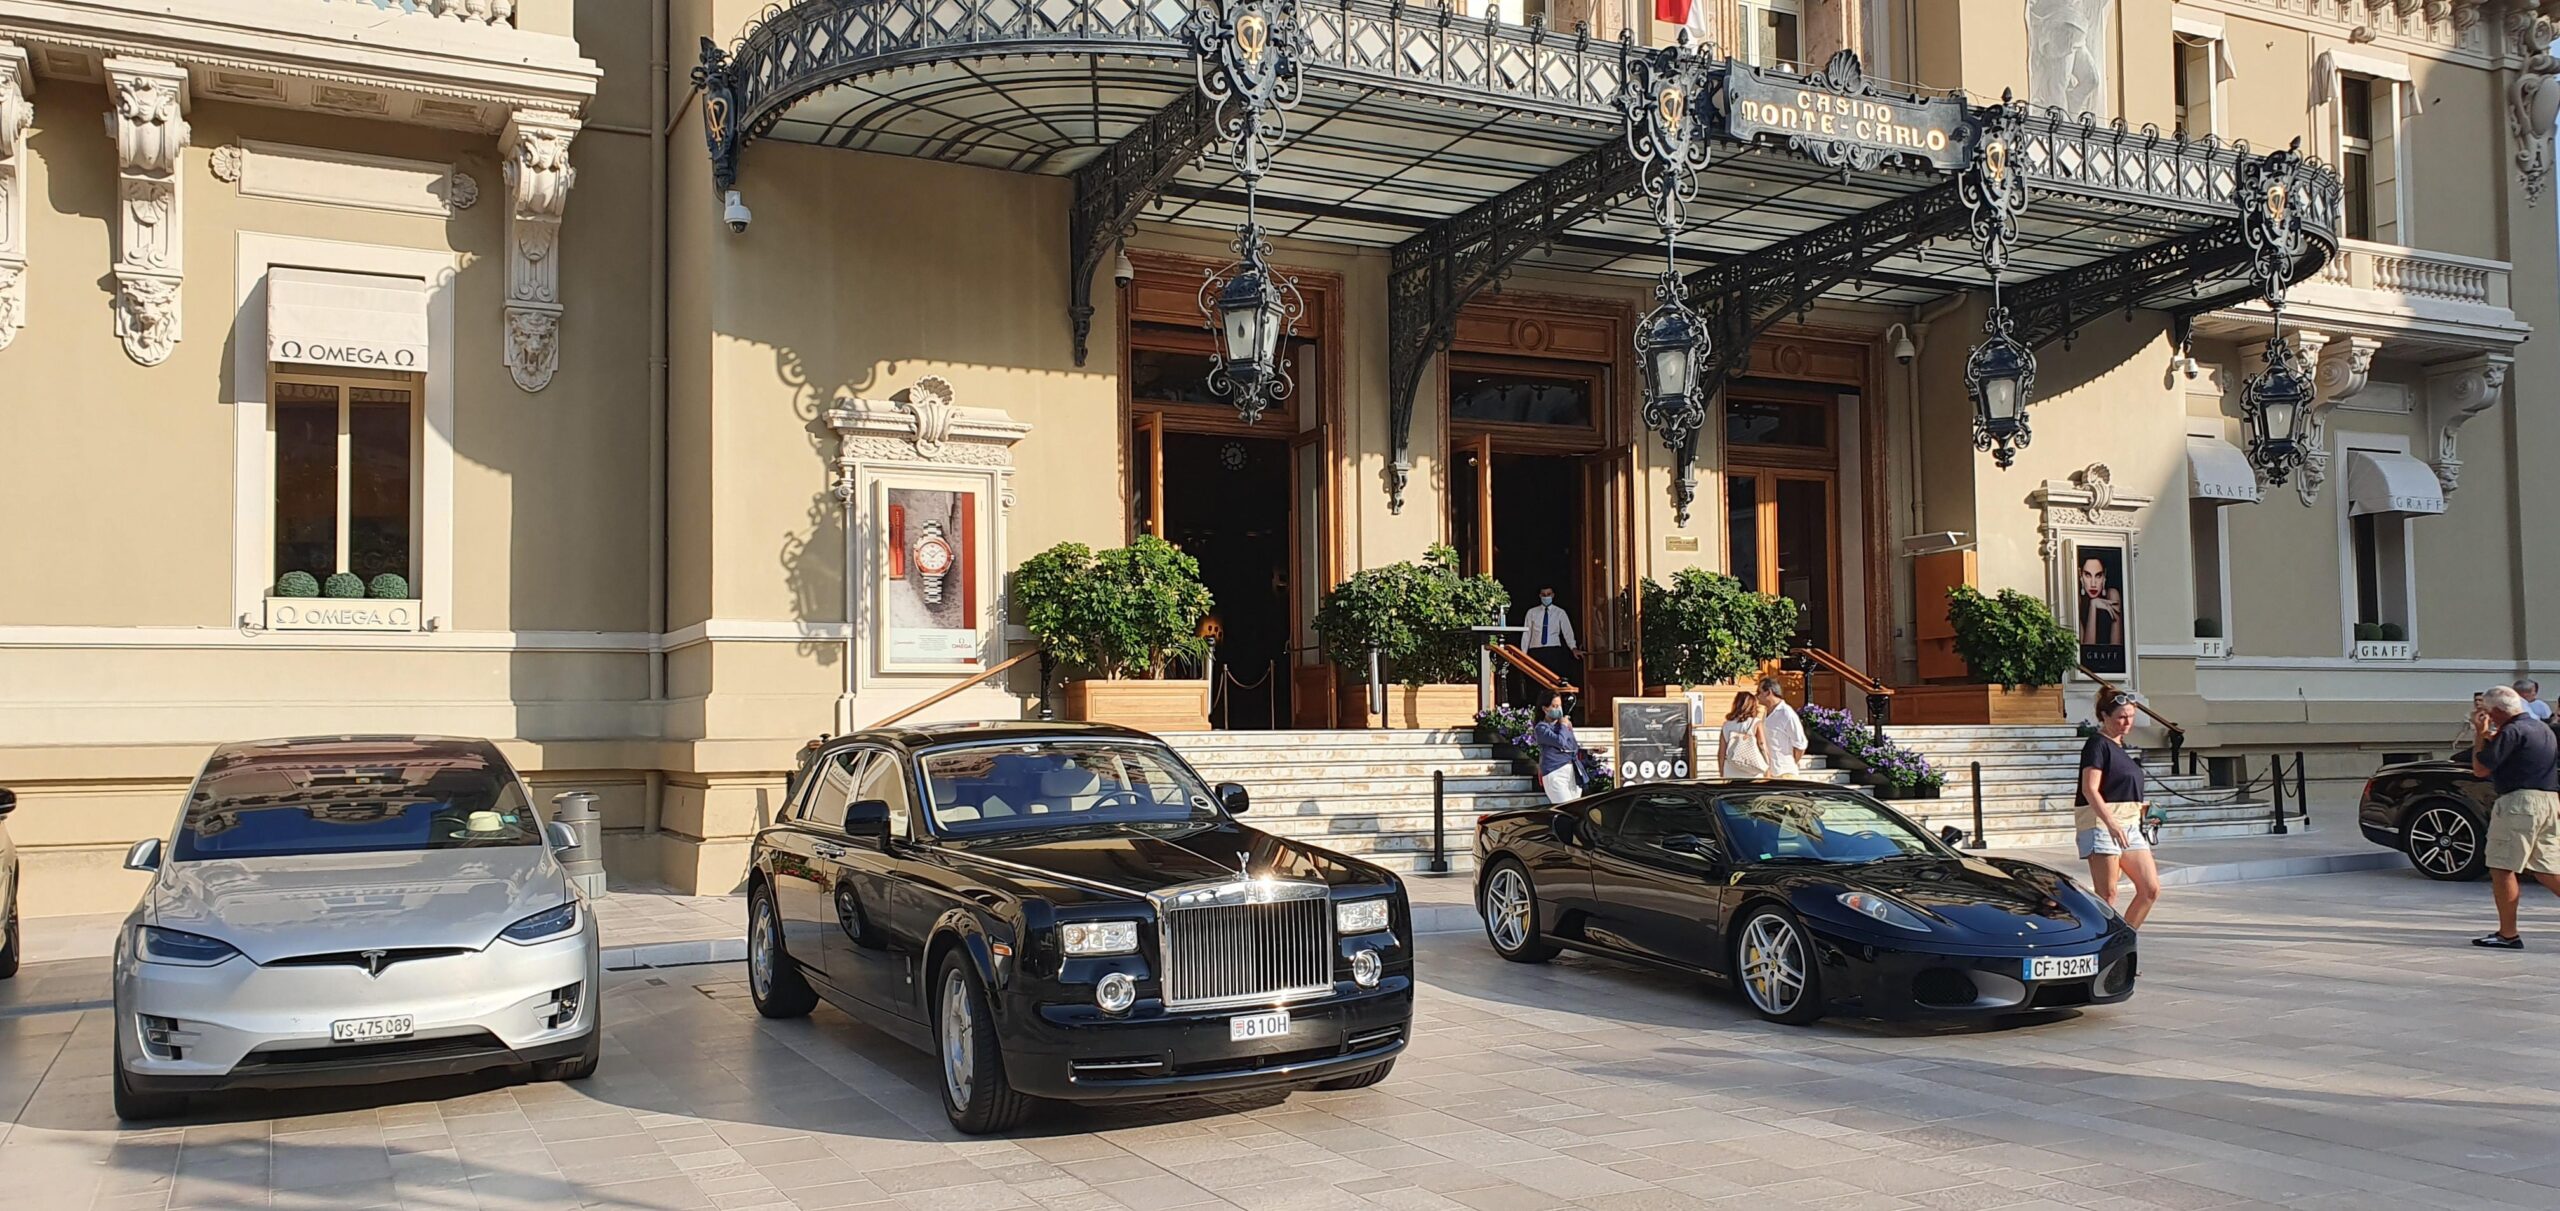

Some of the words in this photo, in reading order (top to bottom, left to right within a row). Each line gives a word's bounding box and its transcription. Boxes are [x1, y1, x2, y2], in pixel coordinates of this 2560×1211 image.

[1797, 91, 1892, 122] CASINO
[308, 344, 389, 365] OMEGA
[2203, 483, 2254, 498] GRAFF
[2395, 497, 2442, 510] GRAFF
[305, 608, 384, 625] OMEGA
[2086, 651, 2118, 660] GRAFF
[2361, 645, 2407, 657] GRAFF
[1246, 1016, 1287, 1036] 810H
